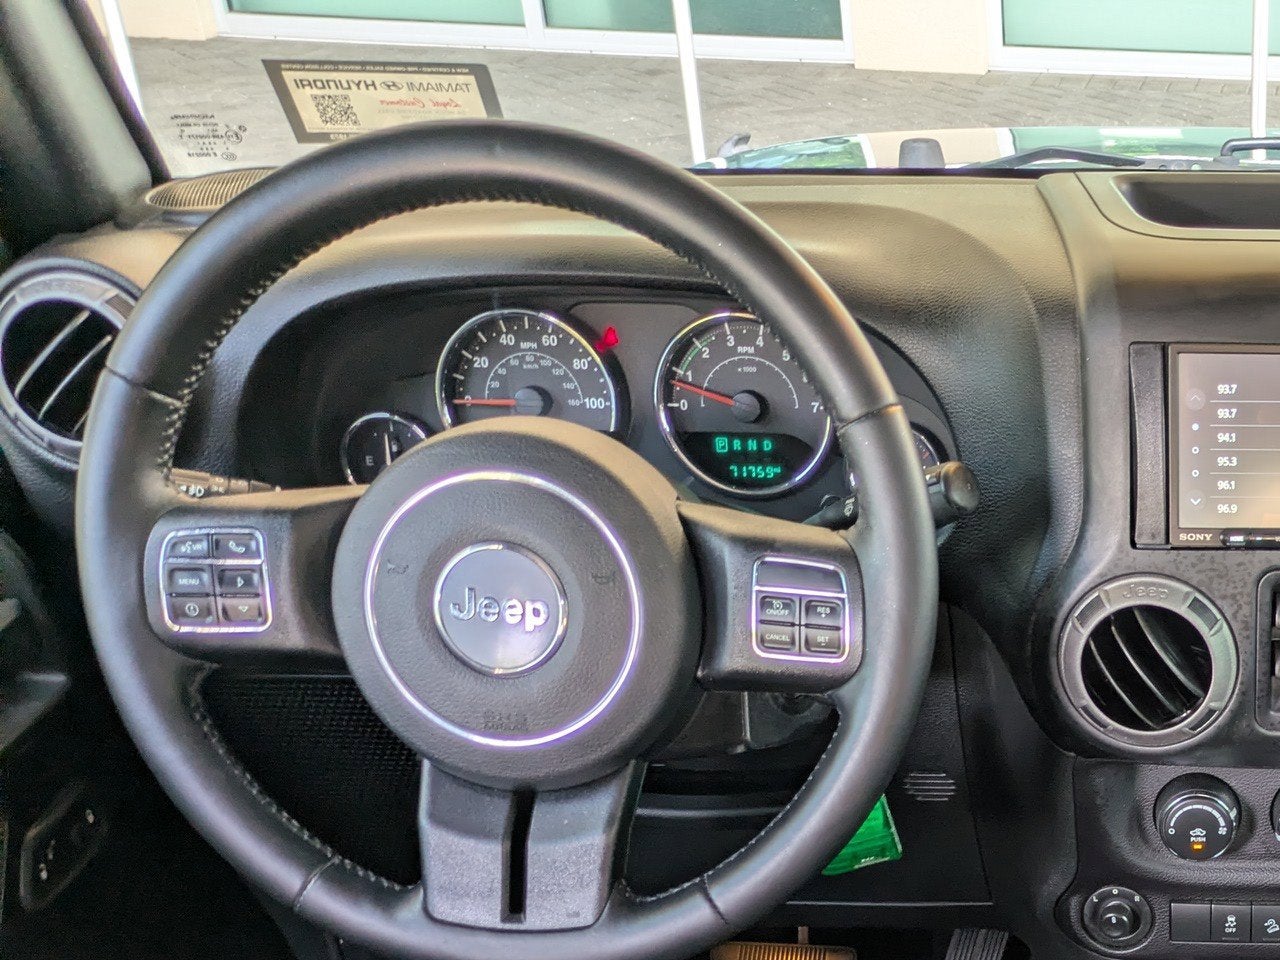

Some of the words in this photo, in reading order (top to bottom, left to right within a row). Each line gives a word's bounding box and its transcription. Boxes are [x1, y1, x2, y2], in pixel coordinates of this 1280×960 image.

[500, 334, 515, 346] 40
[542, 335, 557, 346] 60
[726, 336, 735, 346] 3
[756, 336, 764, 347] 4
[702, 348, 710, 358] 2
[782, 350, 790, 361] 5
[473, 357, 489, 368] 20
[573, 359, 588, 369] 80
[686, 371, 692, 381] 1
[1217, 384, 1237, 394] 93.7
[584, 398, 605, 409] 100
[680, 400, 688, 410] 0
[811, 402, 819, 412] 7
[1217, 408, 1237, 419] 93.7
[1217, 433, 1236, 443] 94.1
[734, 440, 741, 450] R
[748, 440, 757, 450] N
[763, 440, 772, 450] D
[366, 456, 374, 466] E
[1217, 456, 1238, 466] 95.3
[1217, 480, 1236, 490] 96.1
[1217, 504, 1238, 514] 96.9
[1179, 533, 1213, 541] SONY
[1122, 584, 1169, 600] Jeep
[450, 587, 549, 632] Jeep
